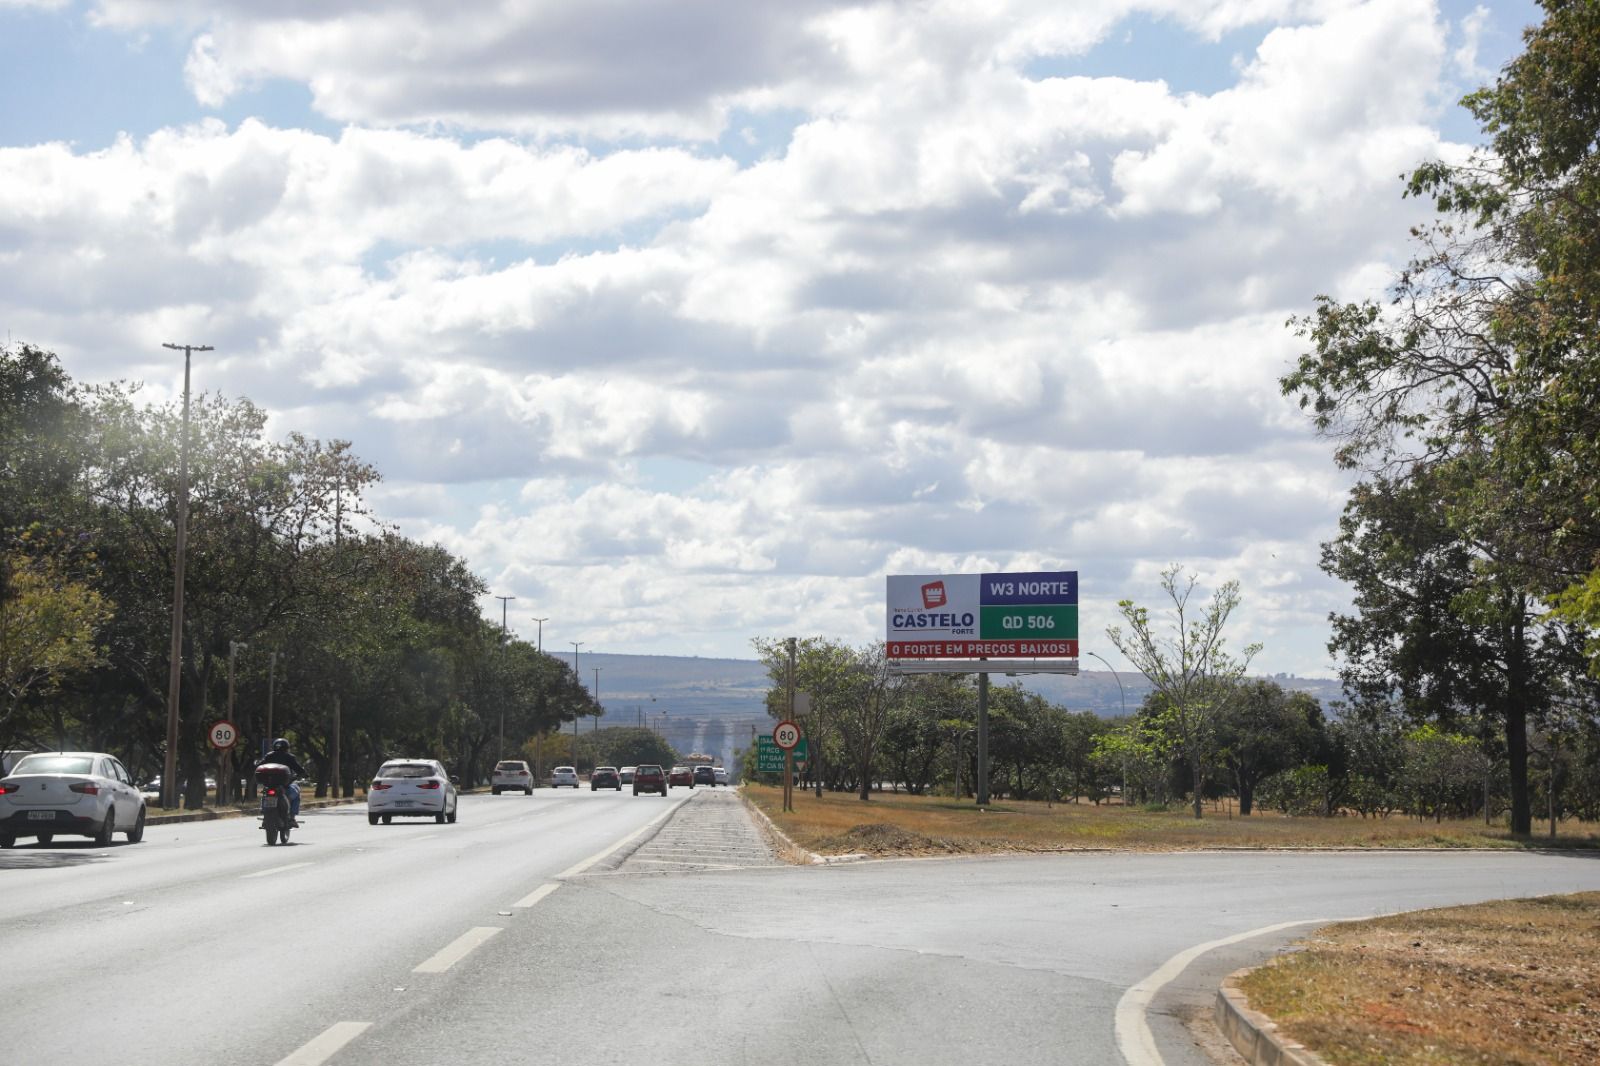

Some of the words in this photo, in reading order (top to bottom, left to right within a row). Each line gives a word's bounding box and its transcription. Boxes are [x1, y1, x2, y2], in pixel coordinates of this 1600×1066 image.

[990, 582, 1014, 596] W3
[1018, 582, 1069, 596] NORTE
[892, 613, 974, 628] CASTELO
[1002, 616, 1023, 629] QD
[1027, 616, 1055, 629] 506
[892, 644, 900, 655] O
[904, 644, 942, 655] FORTE
[946, 644, 963, 654] EM
[967, 643, 1016, 656] PREÇOS
[1020, 643, 1070, 654] BAIXOS!
[216, 730, 231, 740] 80
[780, 730, 794, 741] 80
